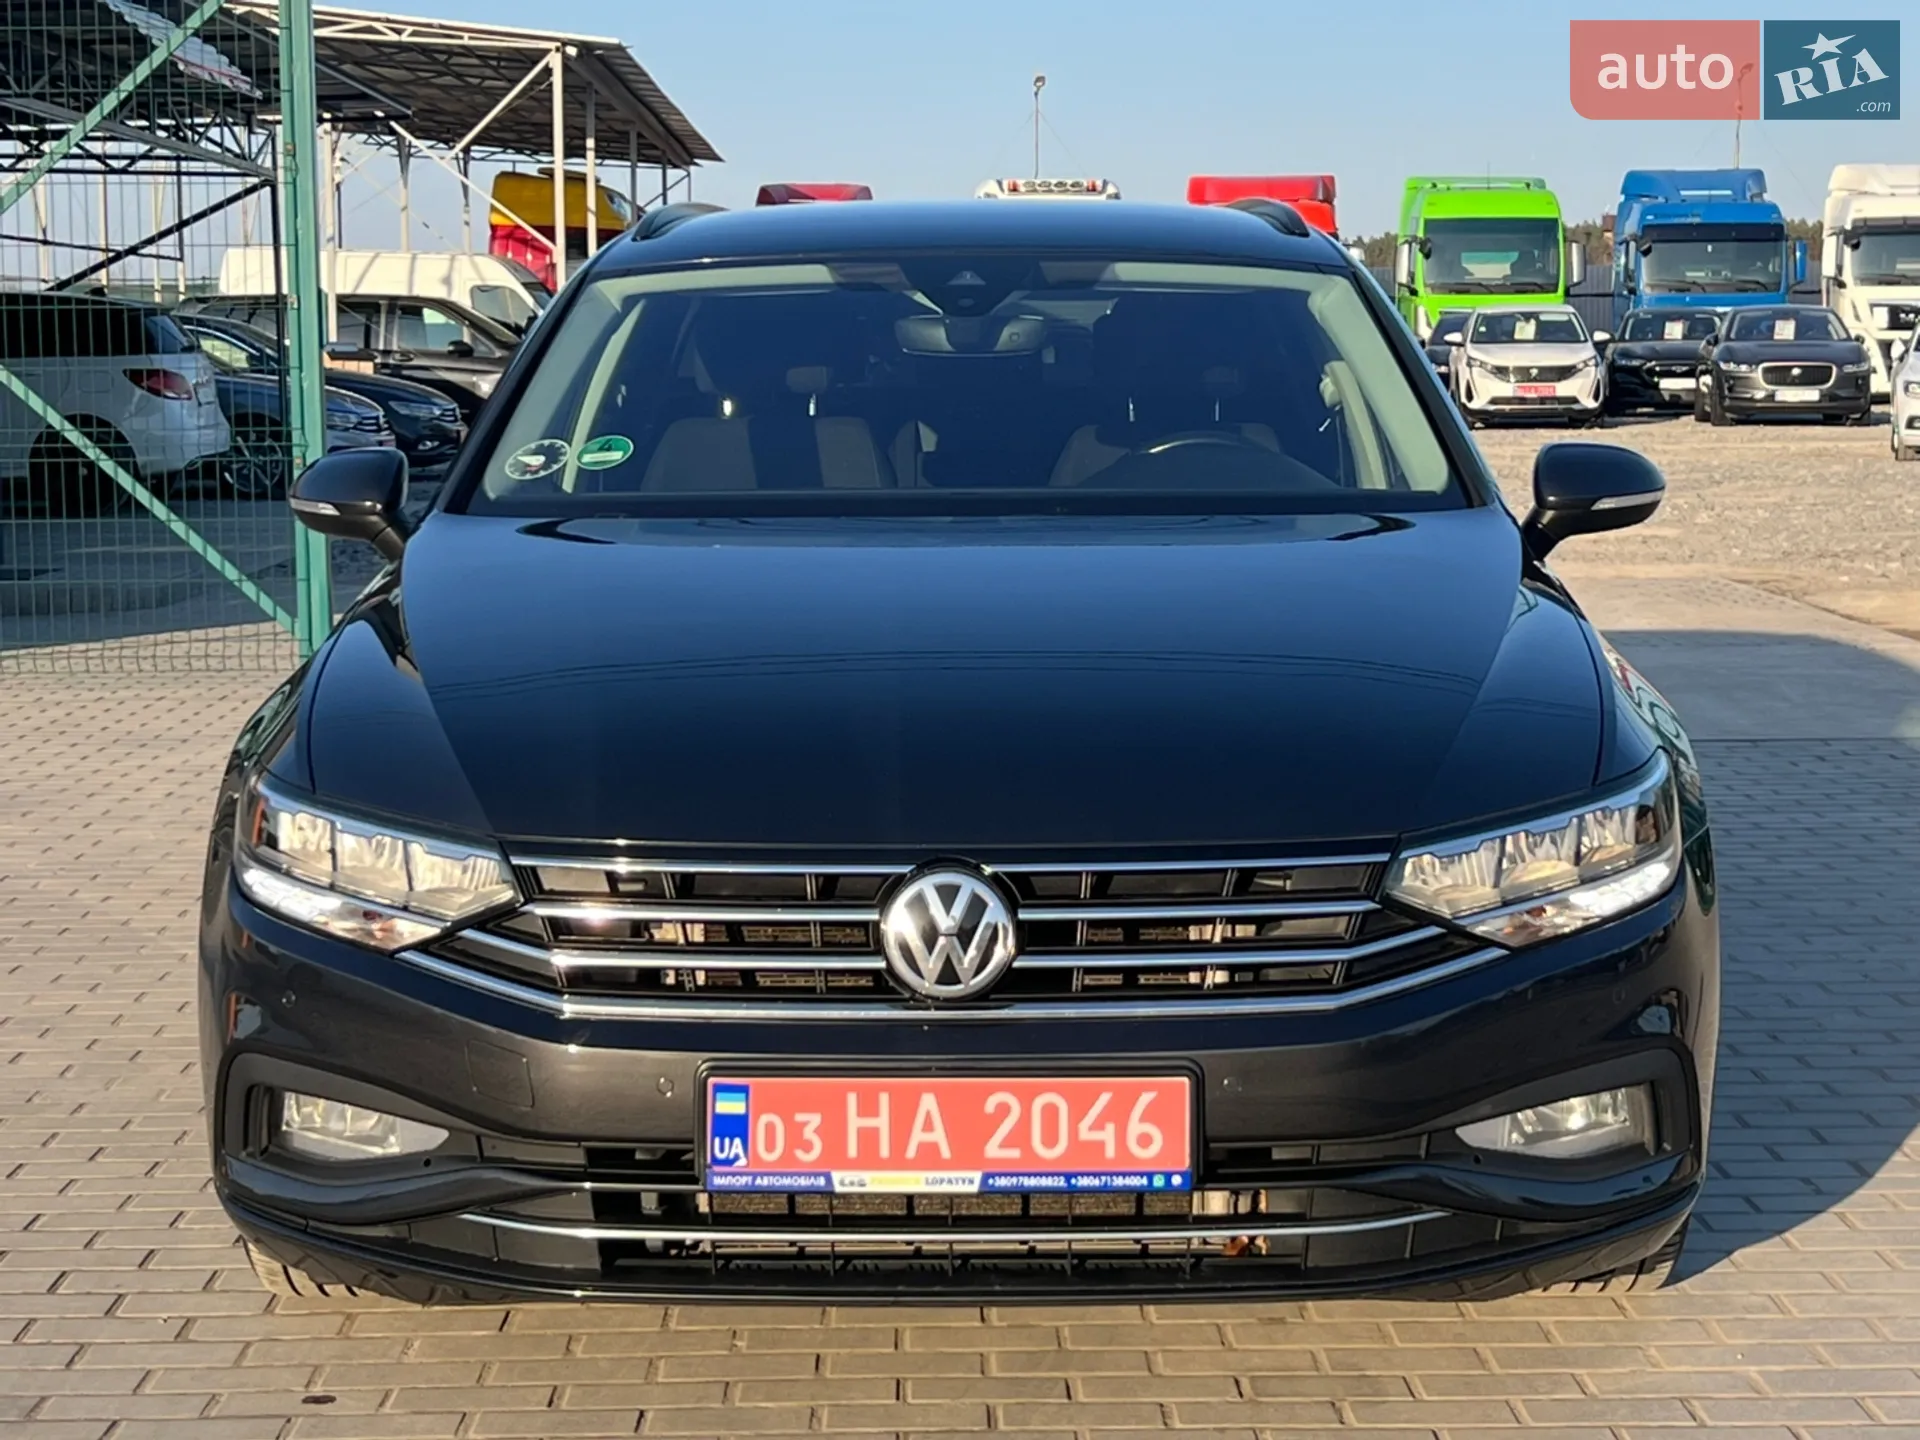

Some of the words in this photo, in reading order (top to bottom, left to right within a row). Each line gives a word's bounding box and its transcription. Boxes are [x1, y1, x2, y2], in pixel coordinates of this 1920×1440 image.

[714, 1137, 746, 1160] UA
[756, 1112, 823, 1162] 03
[846, 1091, 952, 1161] HA
[983, 1091, 1164, 1161] 2046
